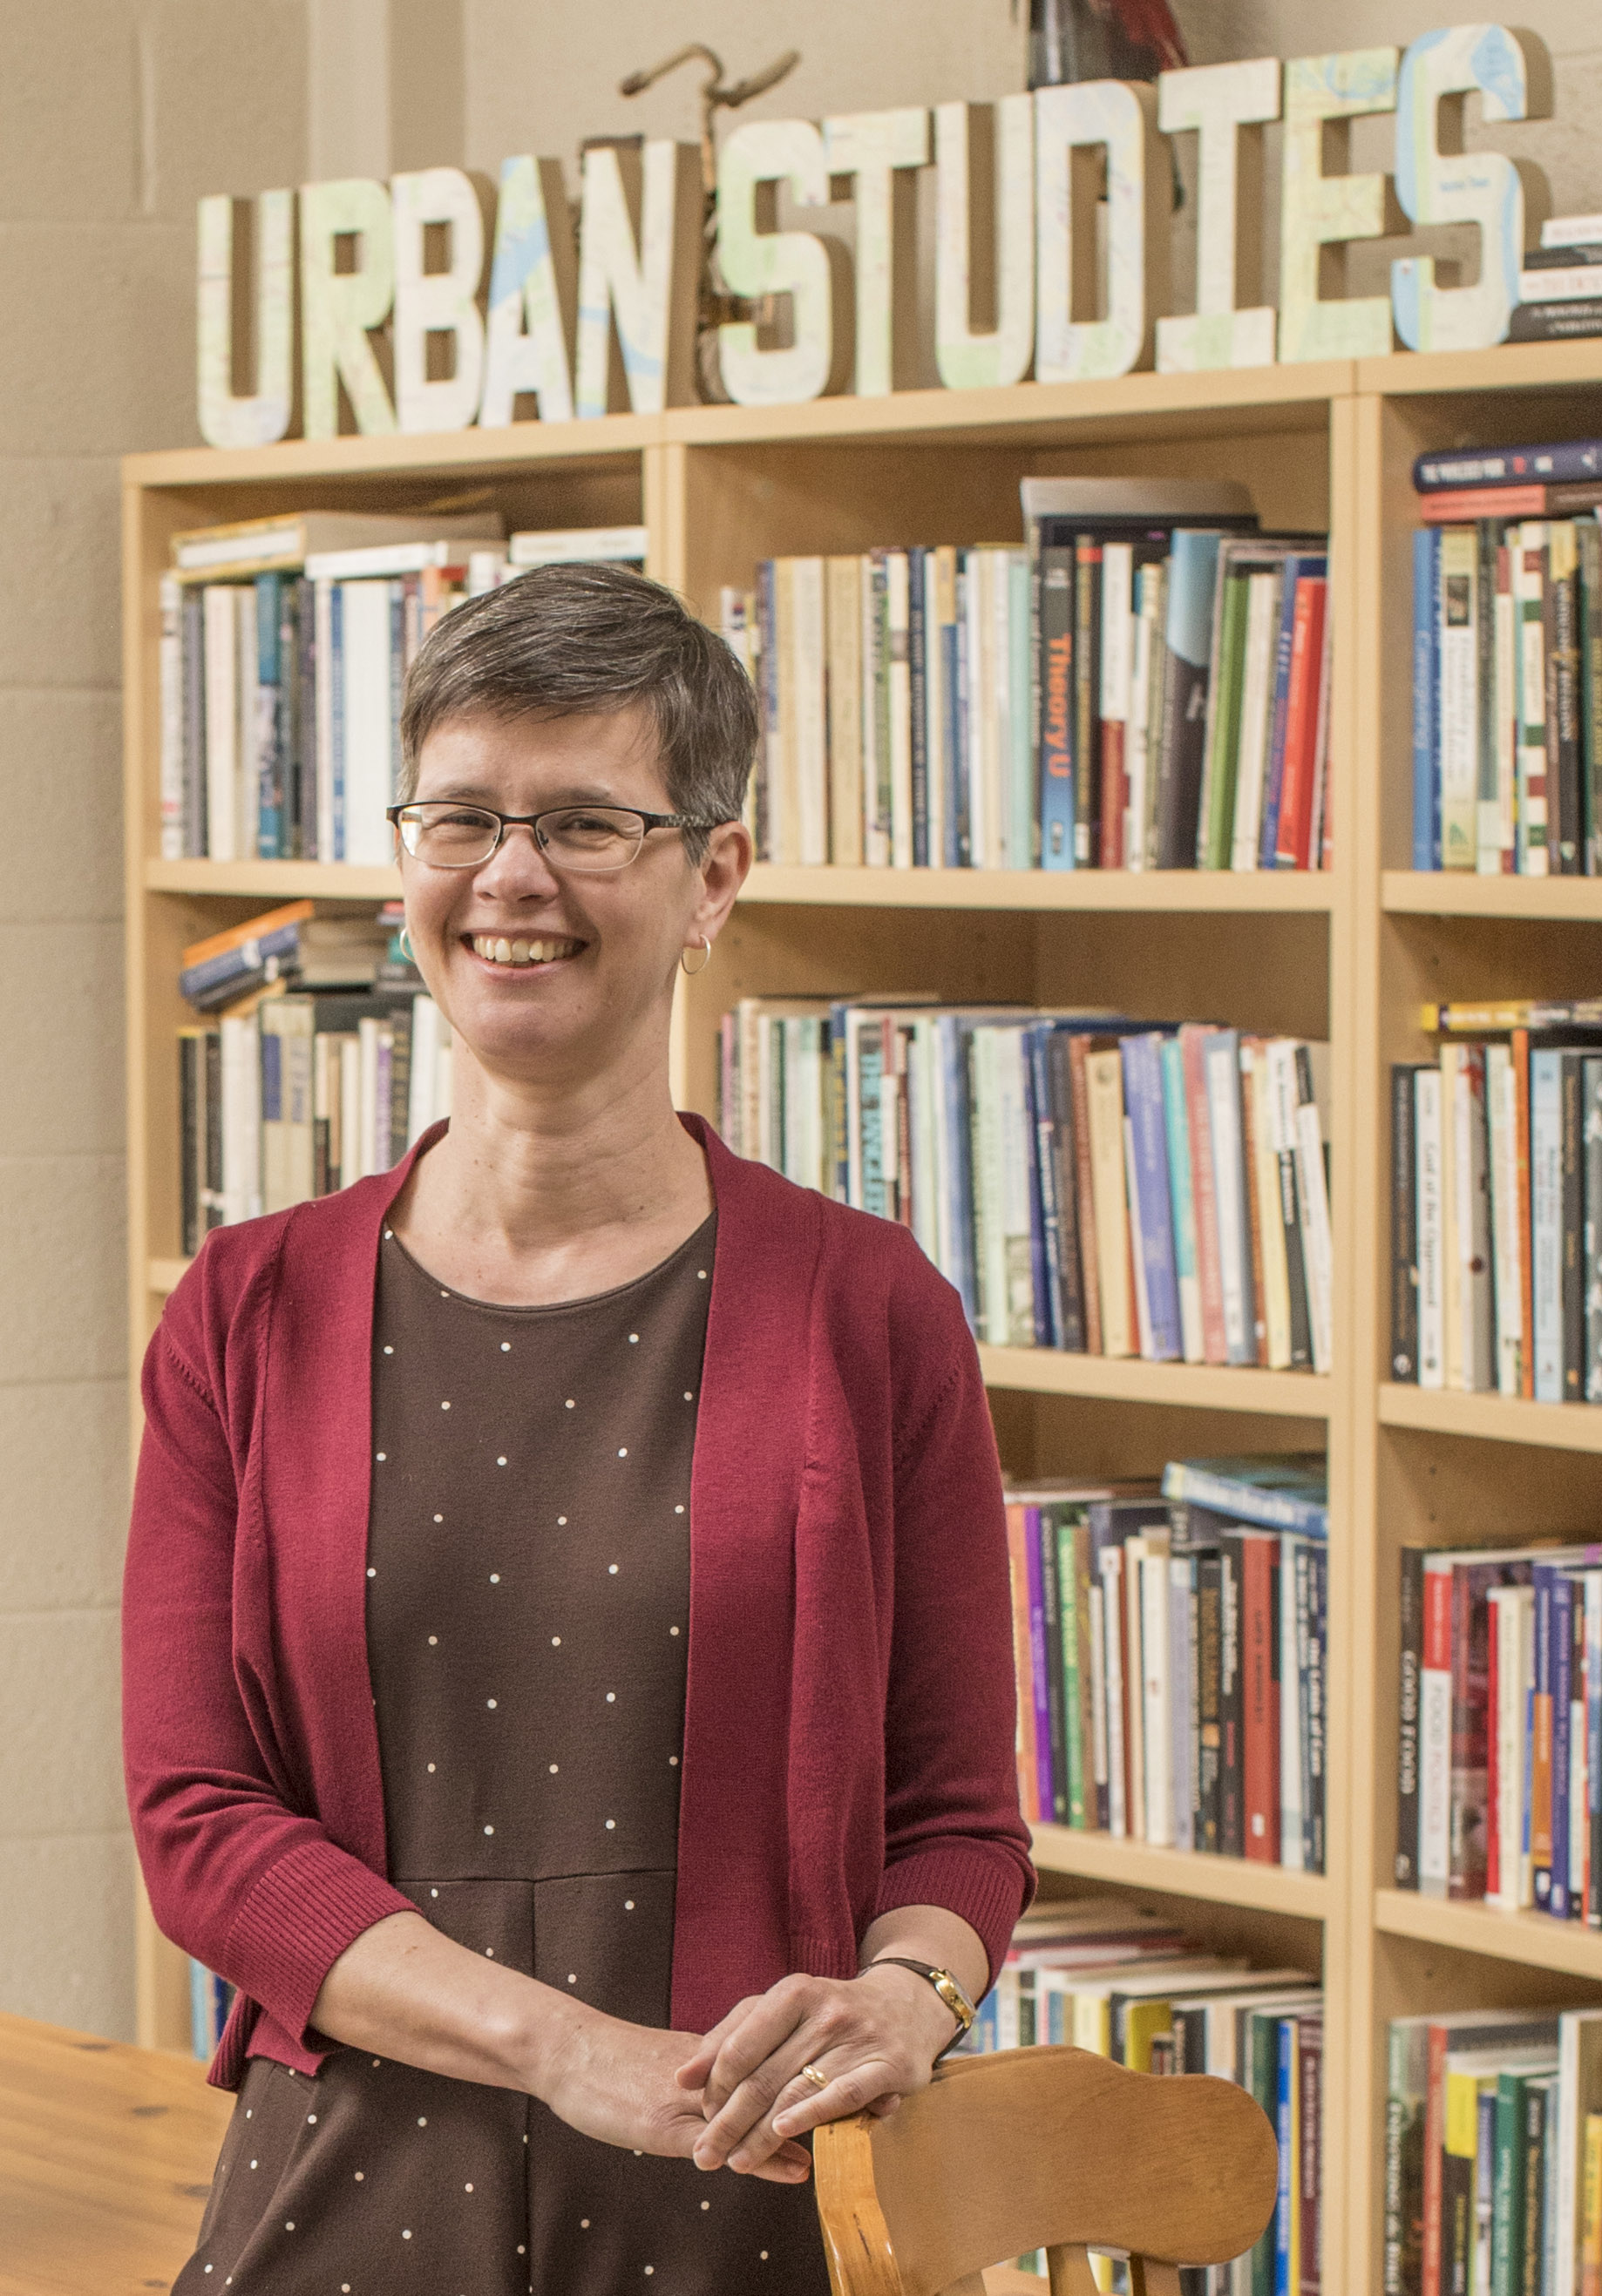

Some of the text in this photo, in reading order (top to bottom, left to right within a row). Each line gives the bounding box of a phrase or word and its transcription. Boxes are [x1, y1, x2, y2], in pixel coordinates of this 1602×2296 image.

[196, 24, 1530, 448] URBAN STUDIES
[1045, 633, 1071, 750] Theory
[1049, 755, 1070, 778] U
[1400, 1650, 1417, 1720] GOOD
